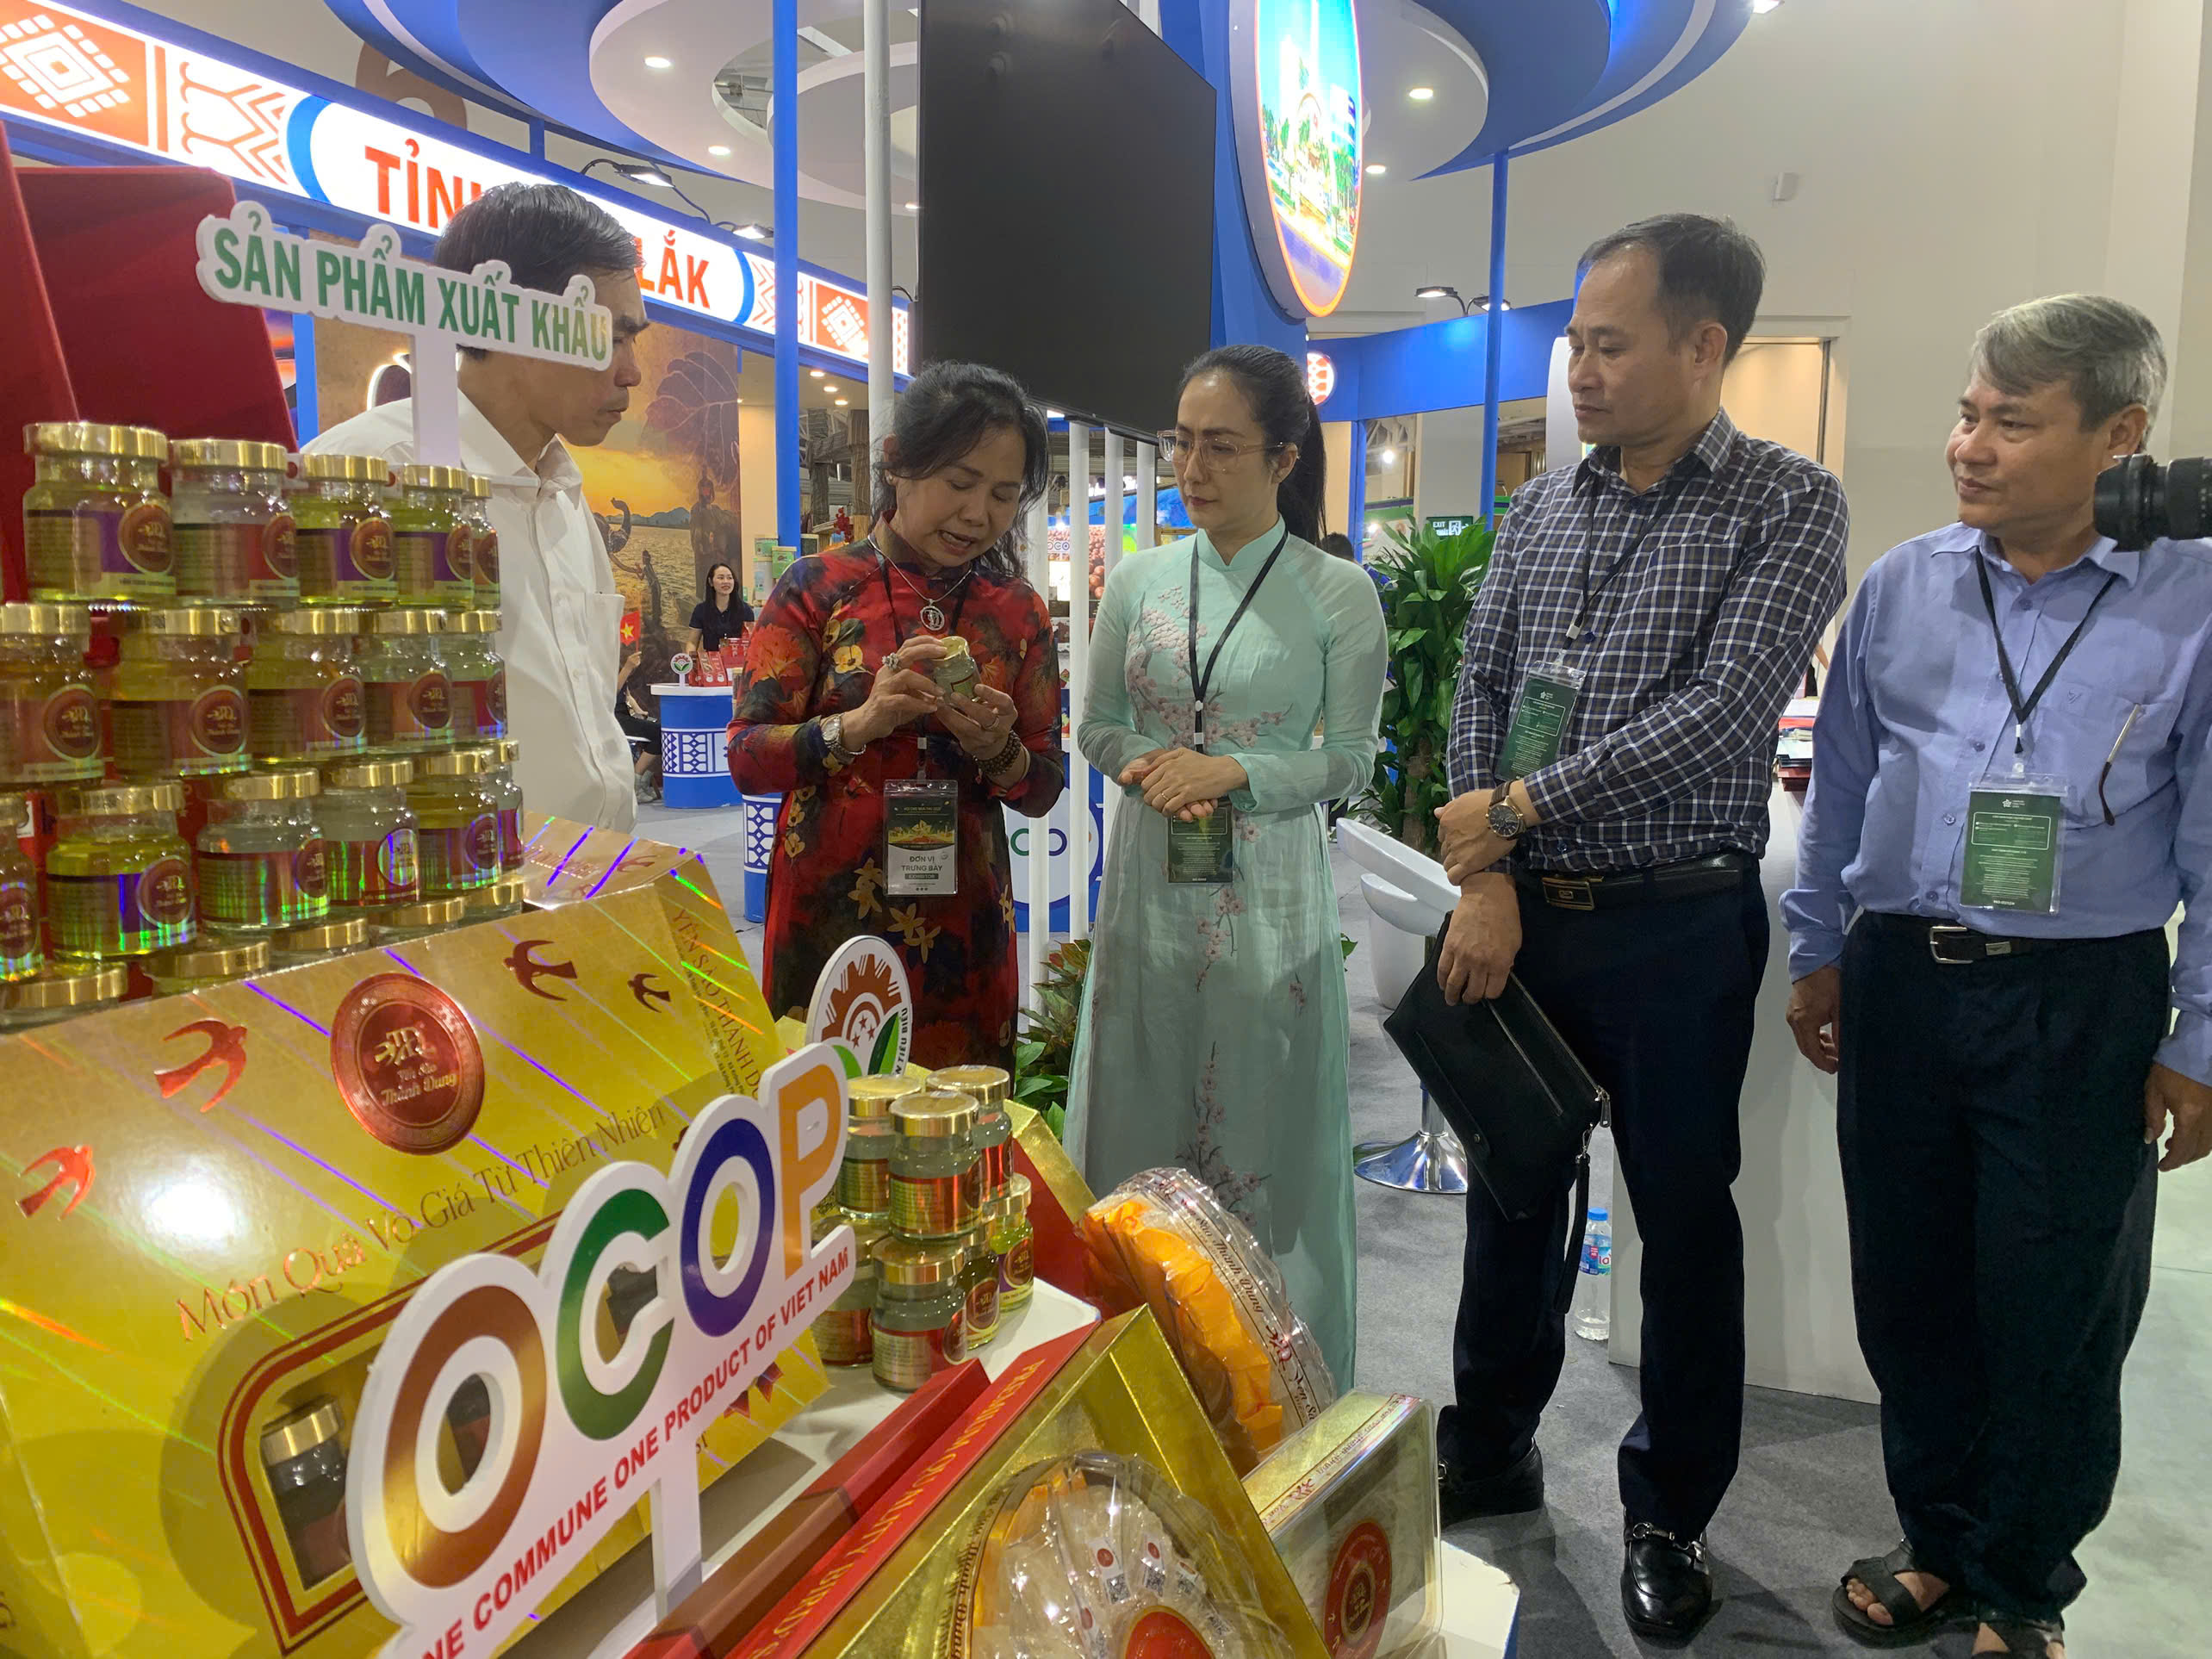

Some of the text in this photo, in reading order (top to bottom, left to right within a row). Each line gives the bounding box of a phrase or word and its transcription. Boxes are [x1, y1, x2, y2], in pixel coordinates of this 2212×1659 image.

[364, 138, 482, 230] TỈN
[214, 209, 607, 362] SẢN PHẨM XUẤT KHẨU
[634, 229, 711, 309] LẮK
[928, 855, 935, 864] VỊ
[745, 1070, 761, 1100] DU
[898, 1036, 908, 1062] TIÊU
[177, 1273, 277, 1342] Món
[419, 1181, 475, 1230] Giá
[514, 1129, 598, 1189] Thiên
[595, 1101, 666, 1155] Nhiên
[384, 1067, 842, 1589] OCOP
[422, 1619, 463, 1659] NE
[473, 1476, 608, 1631] COMMUNE
[613, 1432, 661, 1488] ONE
[662, 1337, 750, 1443] PRODUCT
[755, 1313, 777, 1351] OF
[779, 1283, 817, 1329] VIET
[817, 1246, 849, 1297] NAM
[847, 1453, 956, 1556] QUALITY
